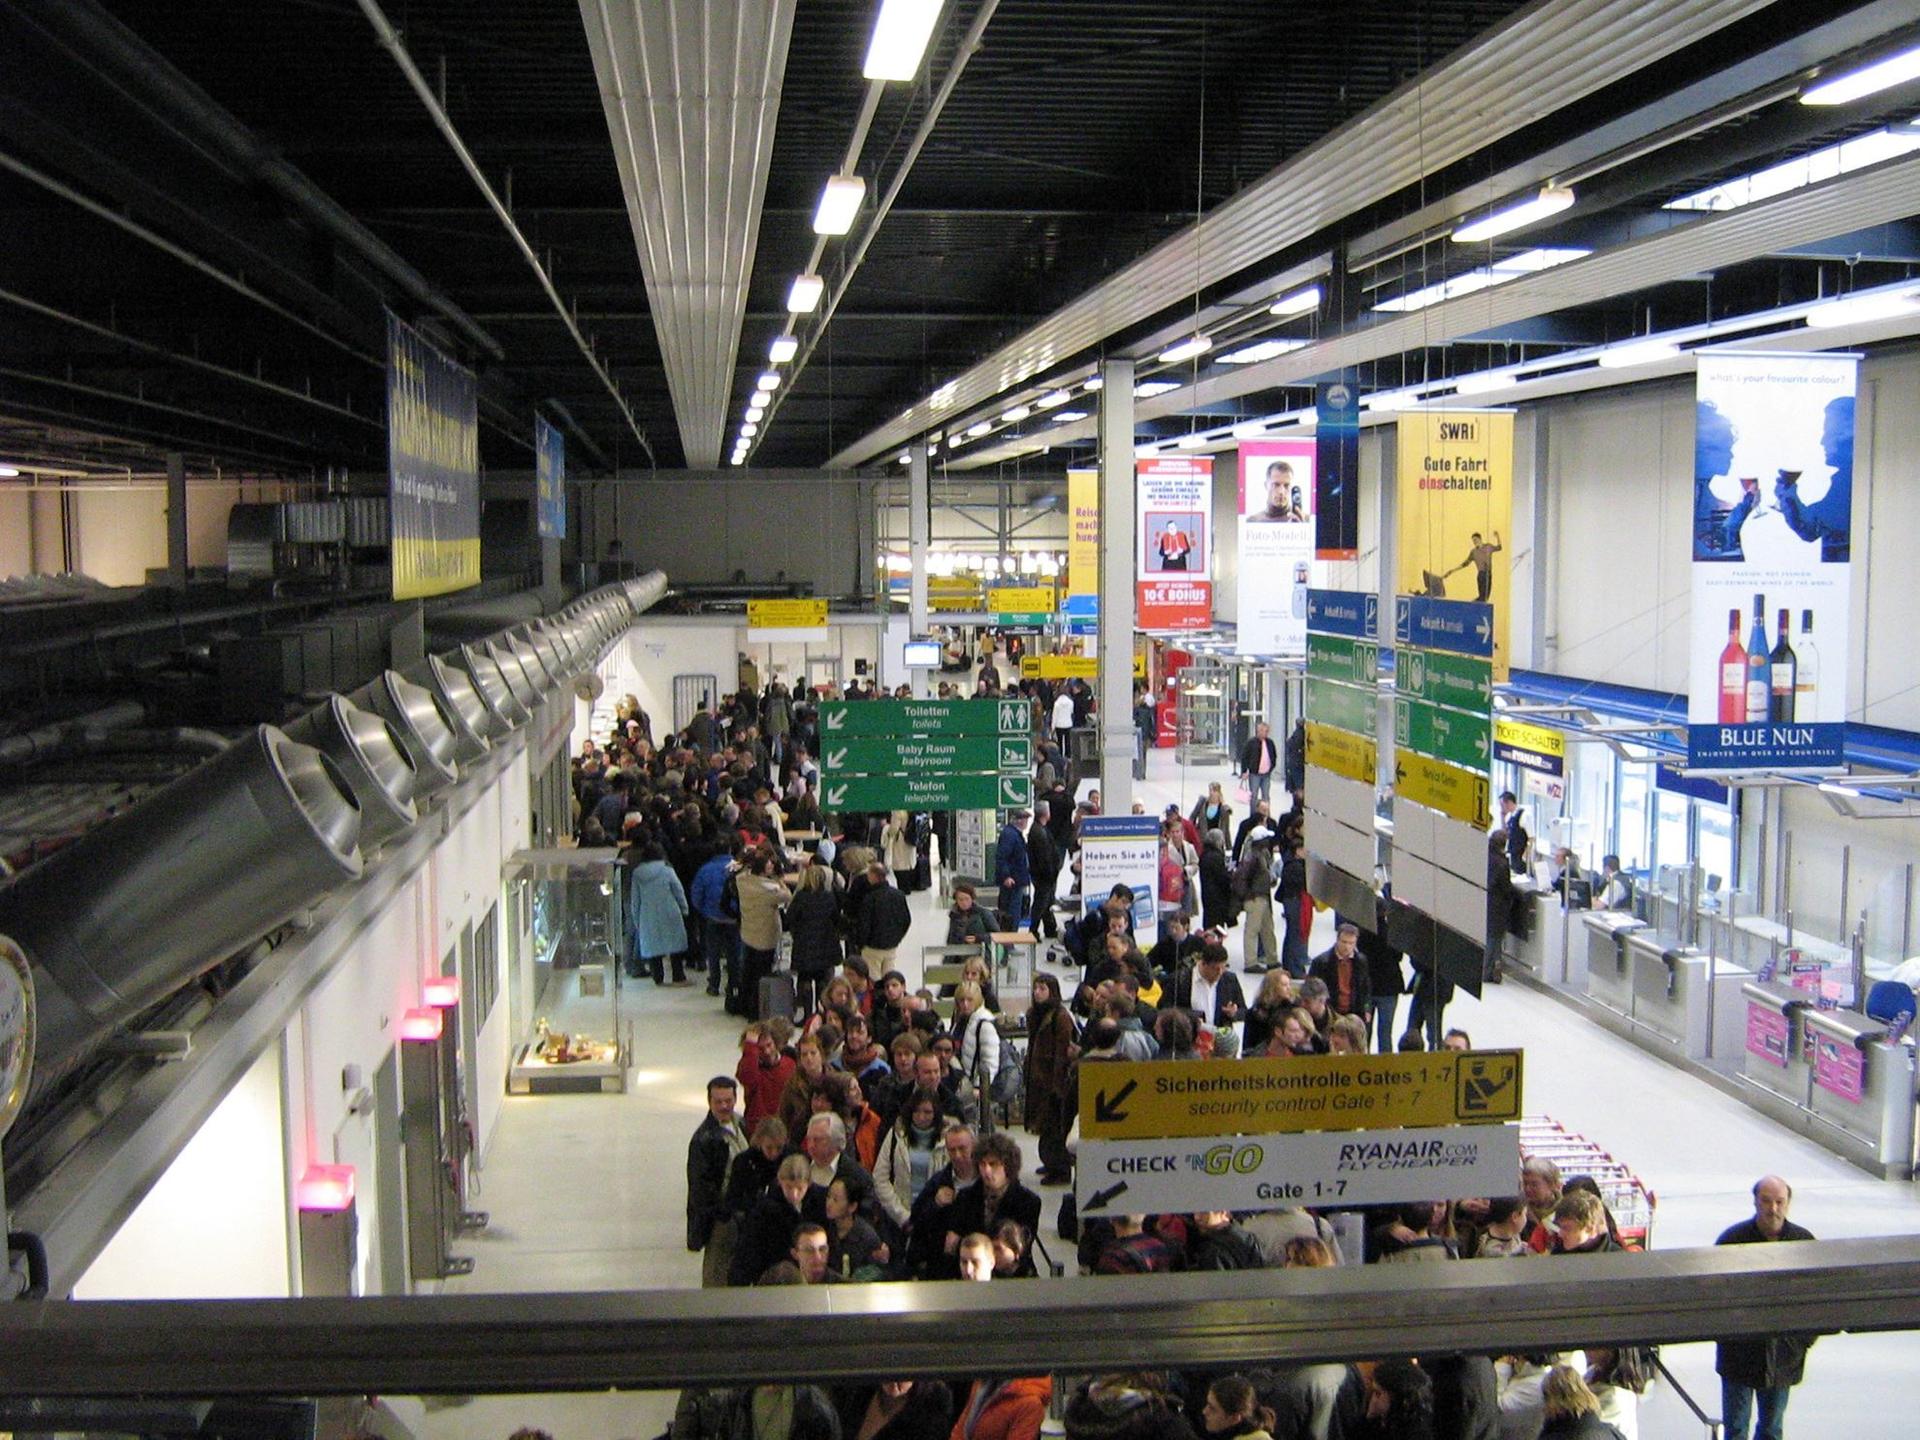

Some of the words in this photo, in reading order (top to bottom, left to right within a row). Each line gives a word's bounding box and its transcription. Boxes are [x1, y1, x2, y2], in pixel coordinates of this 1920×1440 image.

[1742, 375, 1764, 385] your
[1767, 373, 1808, 384] favourite
[1811, 374, 1846, 384] colour?
[1424, 456, 1451, 472] Gute
[1455, 456, 1487, 472] Fahrt
[1419, 475, 1492, 490] einschalten!
[1168, 589, 1206, 601] BONUS
[904, 706, 950, 716] Toiletten
[912, 718, 942, 729] toilets
[1721, 728, 1767, 746] BLUE
[1772, 728, 1814, 746] NUN
[897, 744, 924, 756] Baby
[926, 744, 956, 754] Raum
[902, 757, 951, 767] babyroom
[908, 781, 945, 791] Telefon
[904, 793, 950, 804] telephone
[1085, 852, 1118, 861] Heben
[1121, 851, 1136, 860] Sie
[1140, 851, 1156, 859] ab!
[1156, 1073, 1351, 1094] Sicherheitskontrolle
[1357, 1069, 1412, 1085] Gates
[1188, 1098, 1259, 1116] security
[1265, 1095, 1327, 1112] control
[1332, 1092, 1375, 1110] Gate
[1106, 1155, 1177, 1174] CHECK
[1337, 1159, 1376, 1172] FLY
[1377, 1155, 1477, 1170] CHEAPER
[1256, 1181, 1303, 1199] Gate
